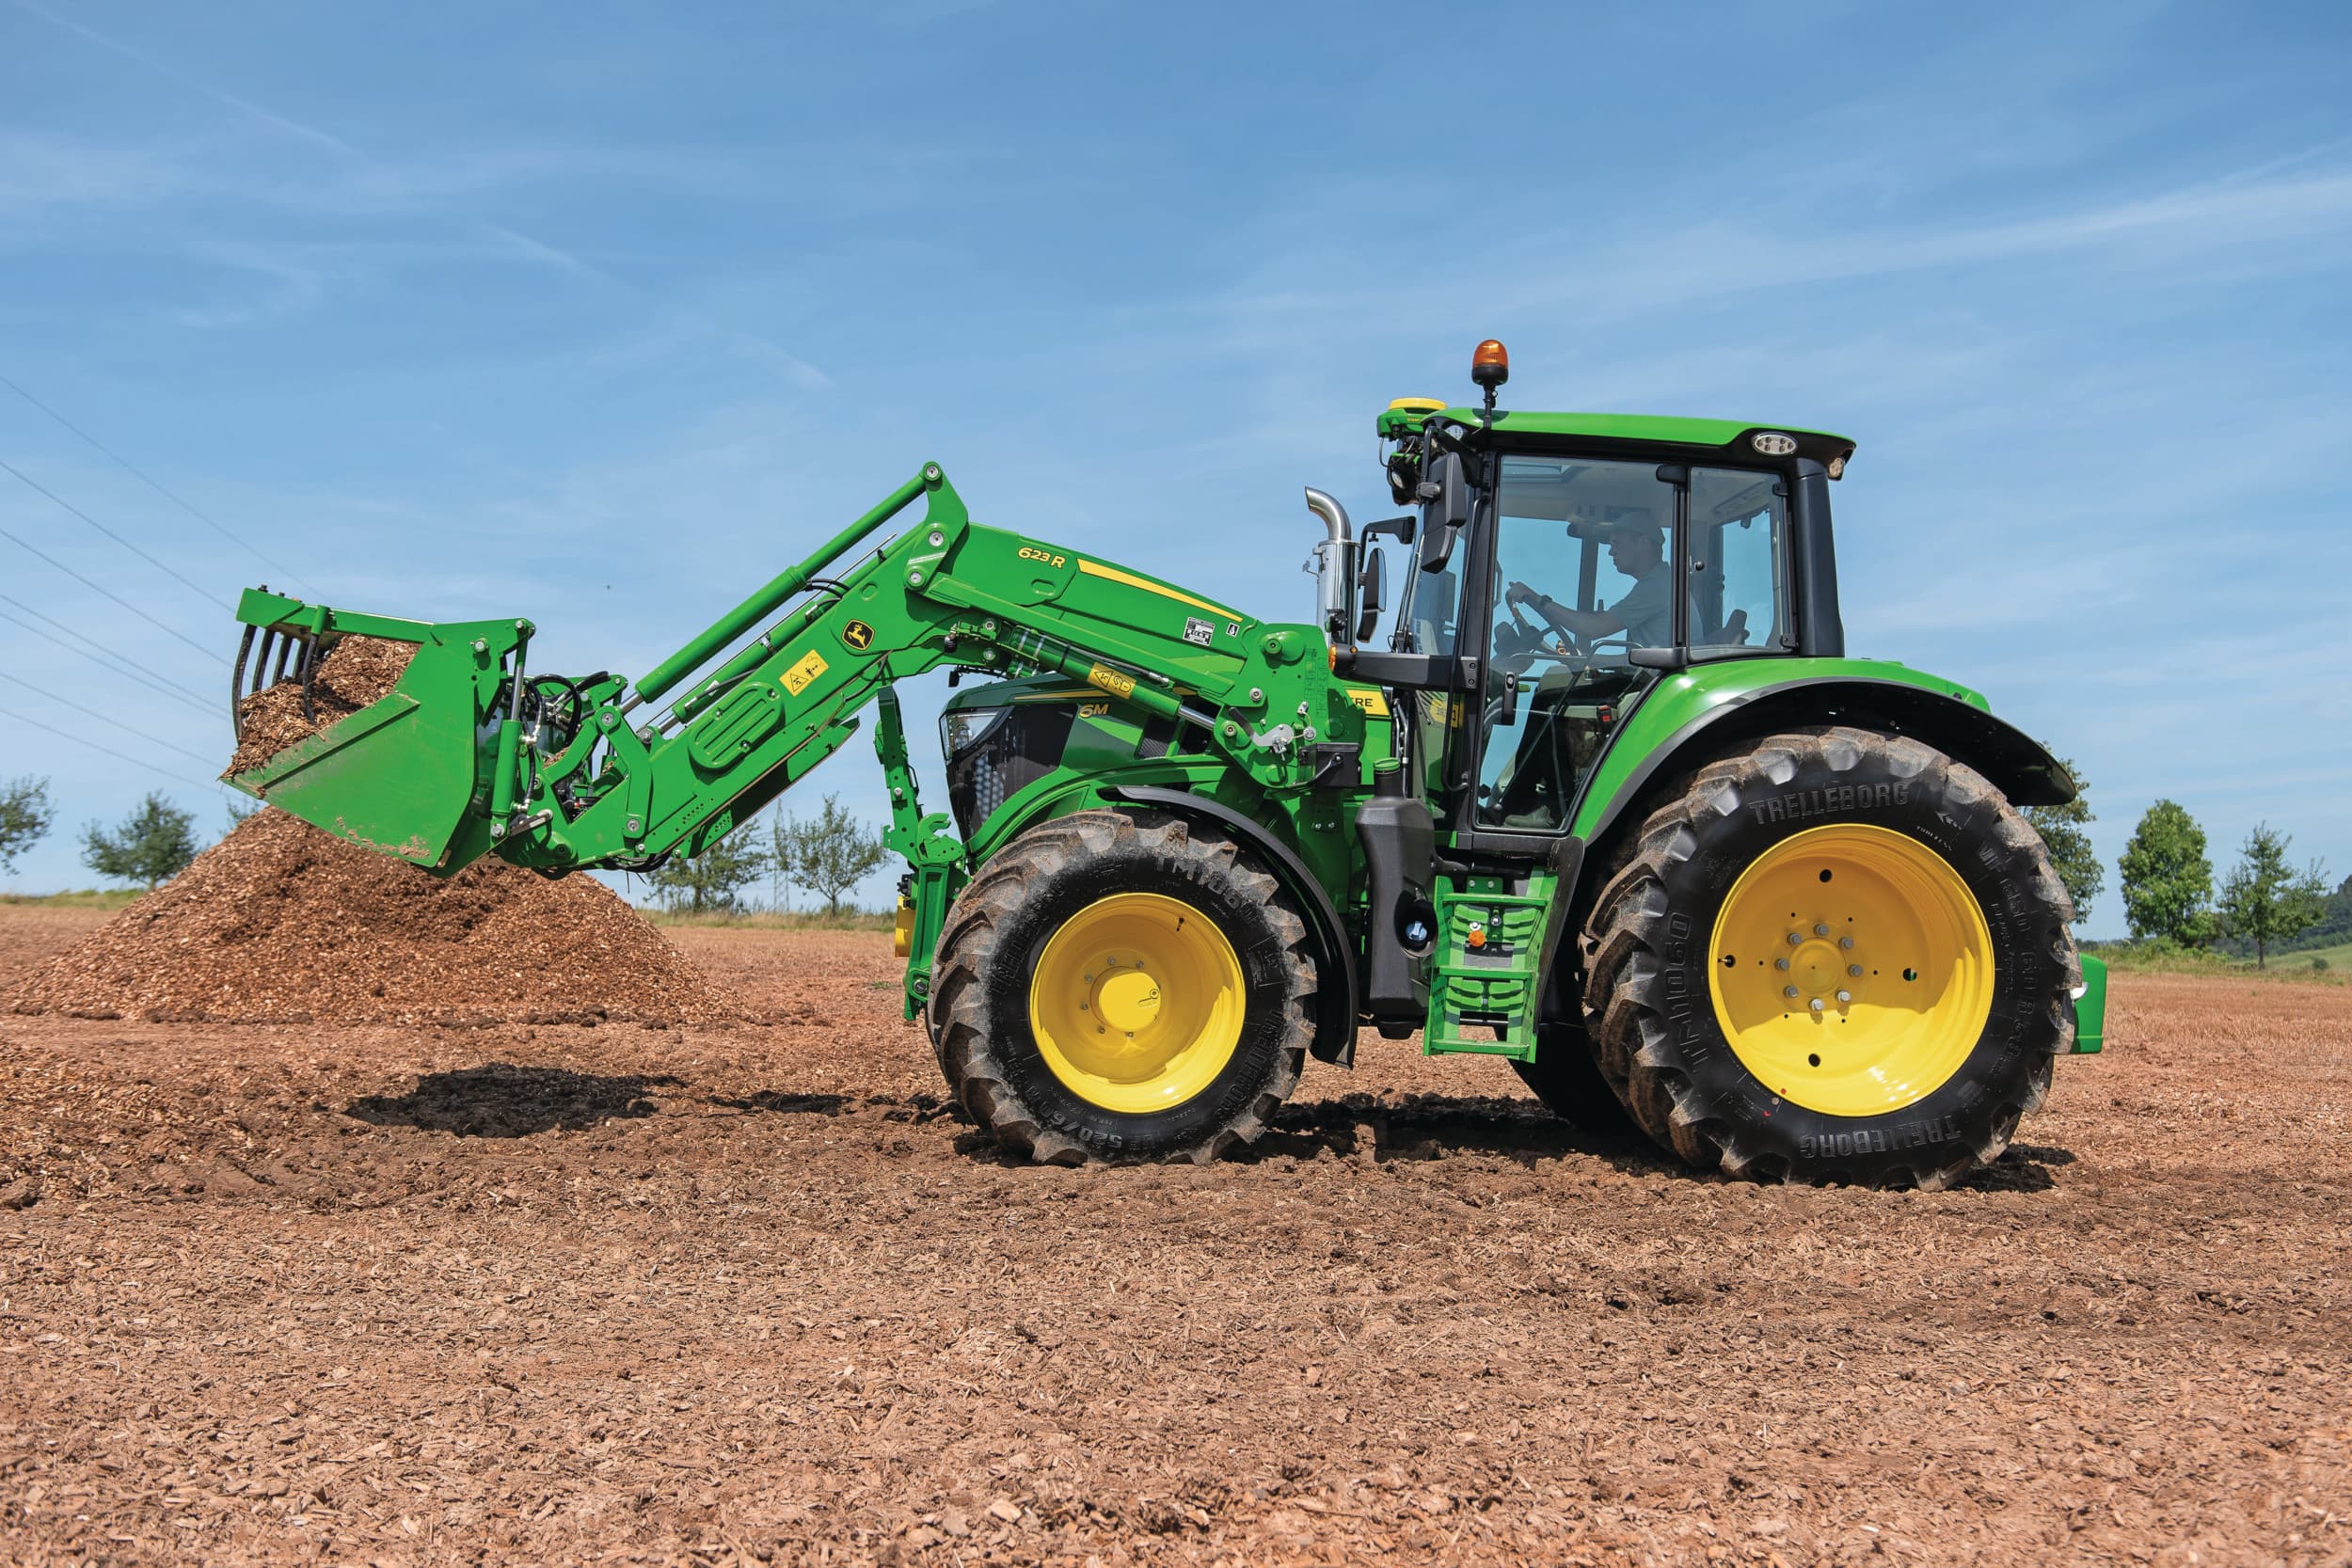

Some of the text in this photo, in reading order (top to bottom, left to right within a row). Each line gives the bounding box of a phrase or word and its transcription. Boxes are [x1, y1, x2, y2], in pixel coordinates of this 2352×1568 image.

[1018, 546, 1066, 569] 623 R
[1079, 704, 1109, 719] 6M
[1351, 697, 1374, 707] RE
[1748, 782, 1910, 825] TRELLEBORG
[1800, 1116, 1963, 1159] TRELLEBORG
